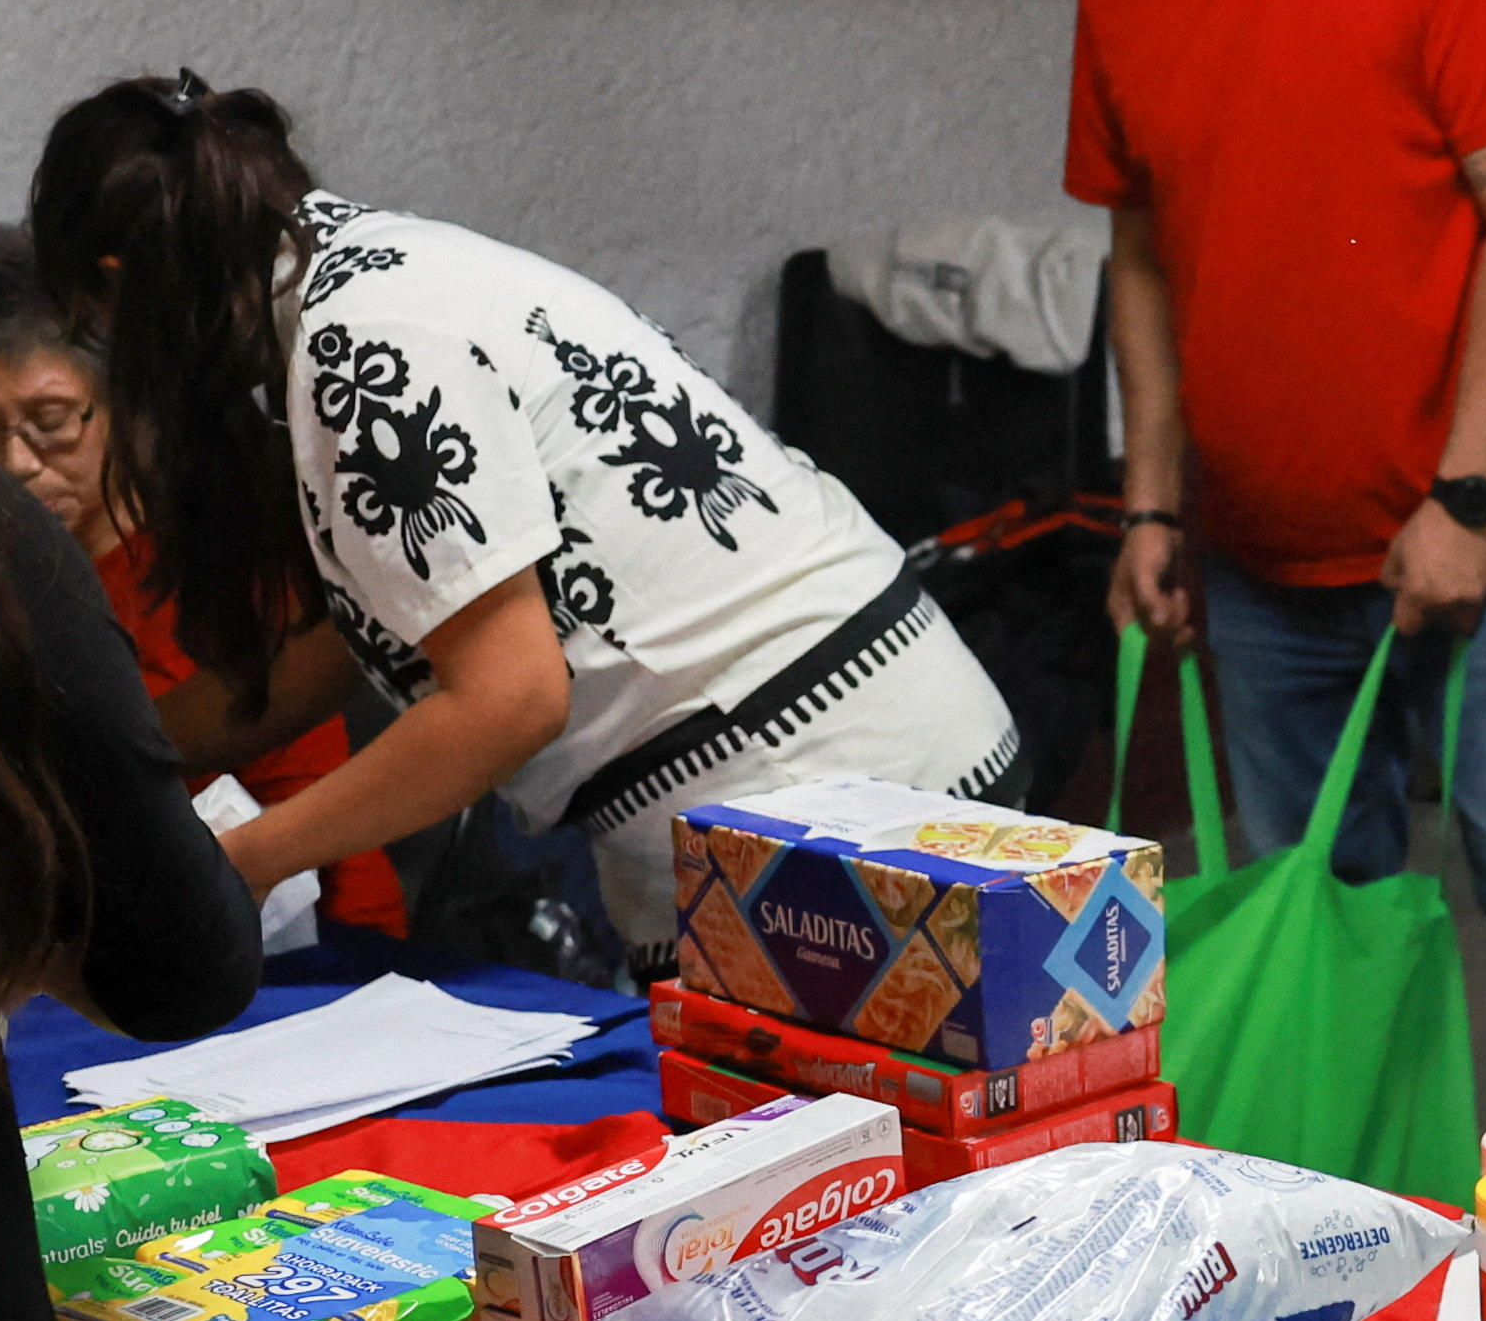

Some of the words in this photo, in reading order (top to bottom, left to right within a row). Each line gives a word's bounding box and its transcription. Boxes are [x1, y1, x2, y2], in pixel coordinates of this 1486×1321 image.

[760, 901, 876, 959] SALADITAS
[1106, 903, 1122, 994] SALADITAS
[671, 1132, 735, 1160] Total
[493, 1159, 646, 1224] Colgate
[760, 1167, 897, 1248] Colgate
[116, 1220, 165, 1249] Cuida
[310, 1227, 439, 1280] Suavelastic
[674, 1219, 737, 1271] Total
[1301, 1226, 1392, 1261] DETERGENTE
[235, 1265, 358, 1304] 297
[274, 1253, 387, 1294] AHORRAPACK
[203, 1278, 310, 1321] TOALLITAS
